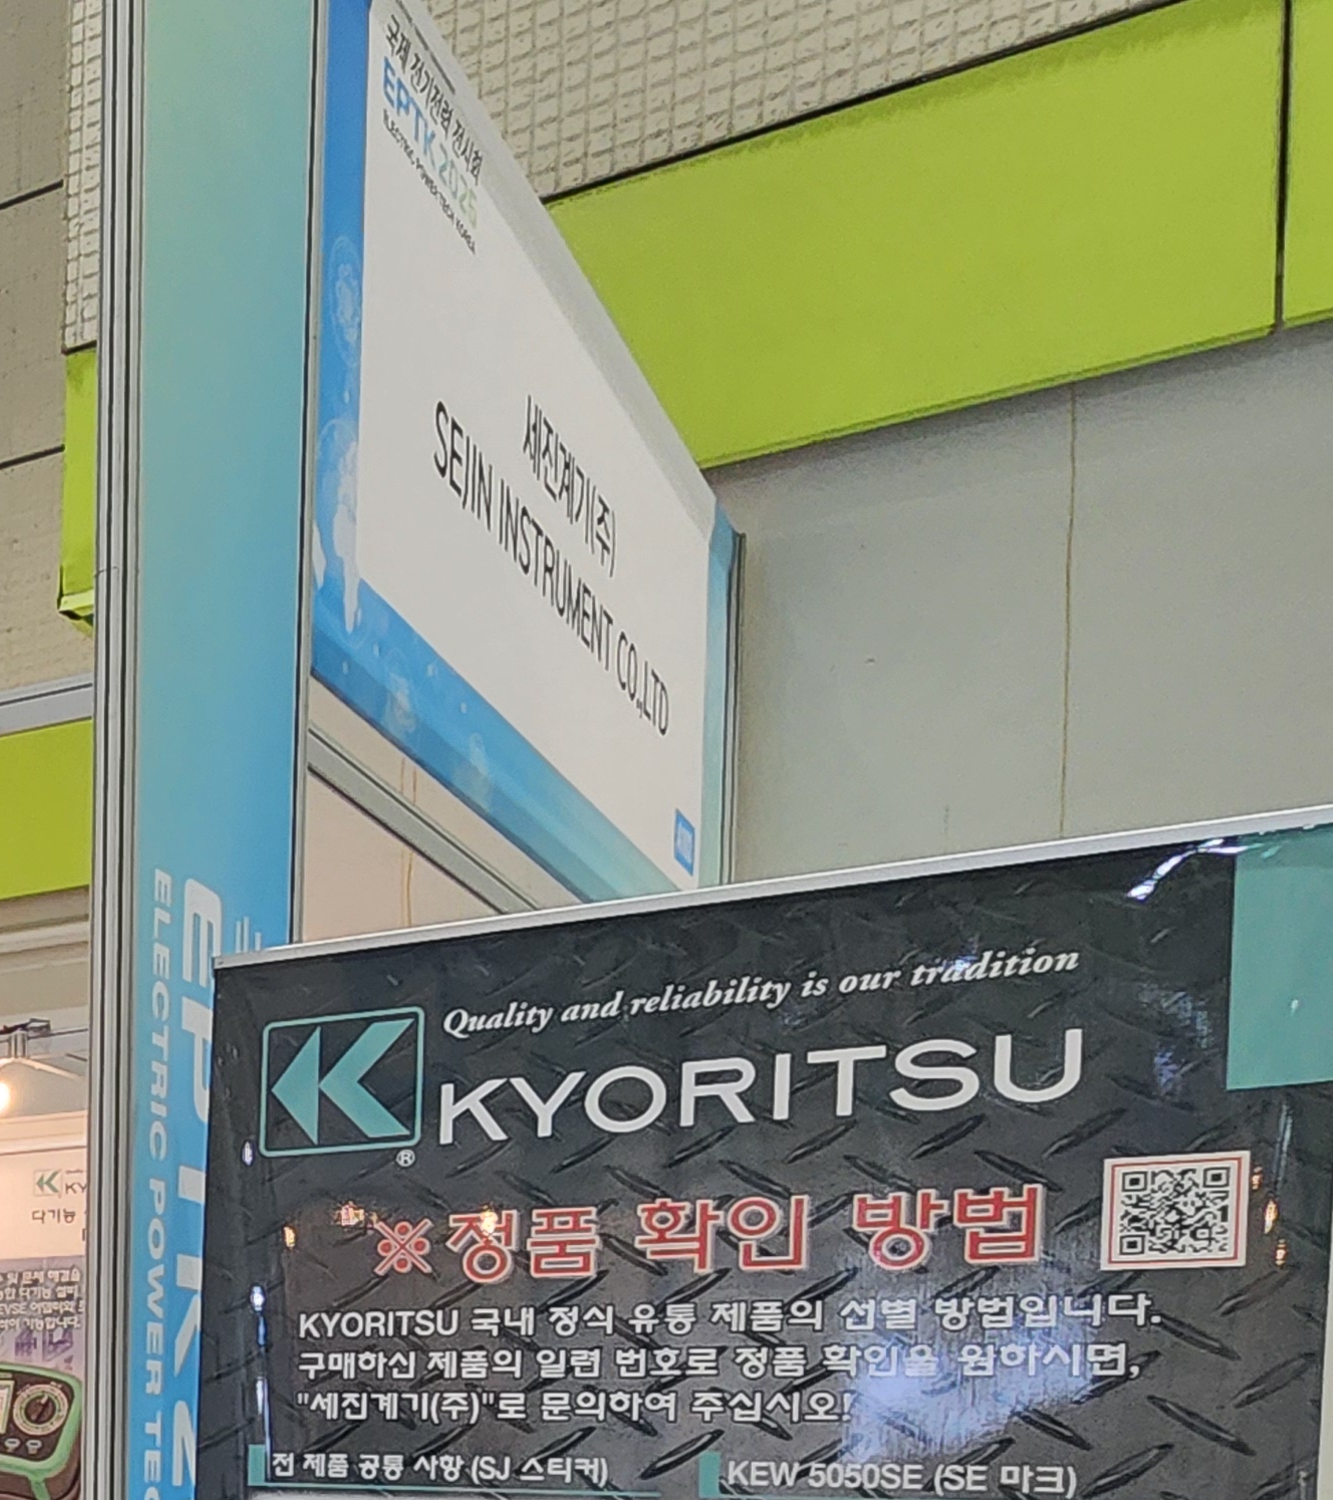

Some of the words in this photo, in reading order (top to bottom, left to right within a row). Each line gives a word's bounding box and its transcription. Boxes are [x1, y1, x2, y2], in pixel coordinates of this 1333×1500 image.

[522, 395, 617, 578] 세진계기(주)
[433, 401, 493, 531] SEJIN
[499, 478, 613, 672] INSTRUMENT
[148, 869, 172, 1162] ELECTRIC
[443, 1001, 553, 1039] Quality
[560, 991, 623, 1025] and
[629, 976, 791, 1016] reliability
[801, 971, 828, 998] is
[839, 970, 900, 994] our
[910, 947, 1080, 986] tradition
[439, 1028, 1083, 1145] KYORITSU
[32, 1209, 76, 1225] 다기능
[635, 1194, 809, 1274] 확인
[852, 1183, 1043, 1272] 방법
[145, 1178, 167, 1396] POWER
[299, 1309, 458, 1338] KYORITSU
[471, 1308, 534, 1337] 국내
[547, 1306, 614, 1336] 정식
[629, 1304, 696, 1335] 유통
[710, 1300, 823, 1332] 제품의
[840, 1298, 916, 1330] 선별
[935, 1293, 1162, 1330] 방법입니다.
[297, 1393, 526, 1424] "세진계기(주)"로
[540, 1392, 676, 1423] 문의하여
[691, 1391, 852, 1423] 주십시오!
[298, 1351, 416, 1380] 구매하신
[428, 1349, 522, 1379] 제품의
[536, 1347, 601, 1378] 일련
[616, 1346, 718, 1376] 번호로
[735, 1347, 806, 1378] 정품
[821, 1345, 939, 1378] 확인을
[272, 1453, 295, 1475] 전
[302, 1454, 349, 1476] 제품
[358, 1455, 405, 1478] 공통
[413, 1456, 463, 1482] 사항
[470, 1457, 511, 1484] (SJ
[520, 1458, 609, 1487] 스티커)
[727, 1461, 800, 1488] KEW
[808, 1462, 923, 1490] 5050SE
[934, 1464, 987, 1496] (SE
[1000, 1465, 1078, 1498] 마크)
